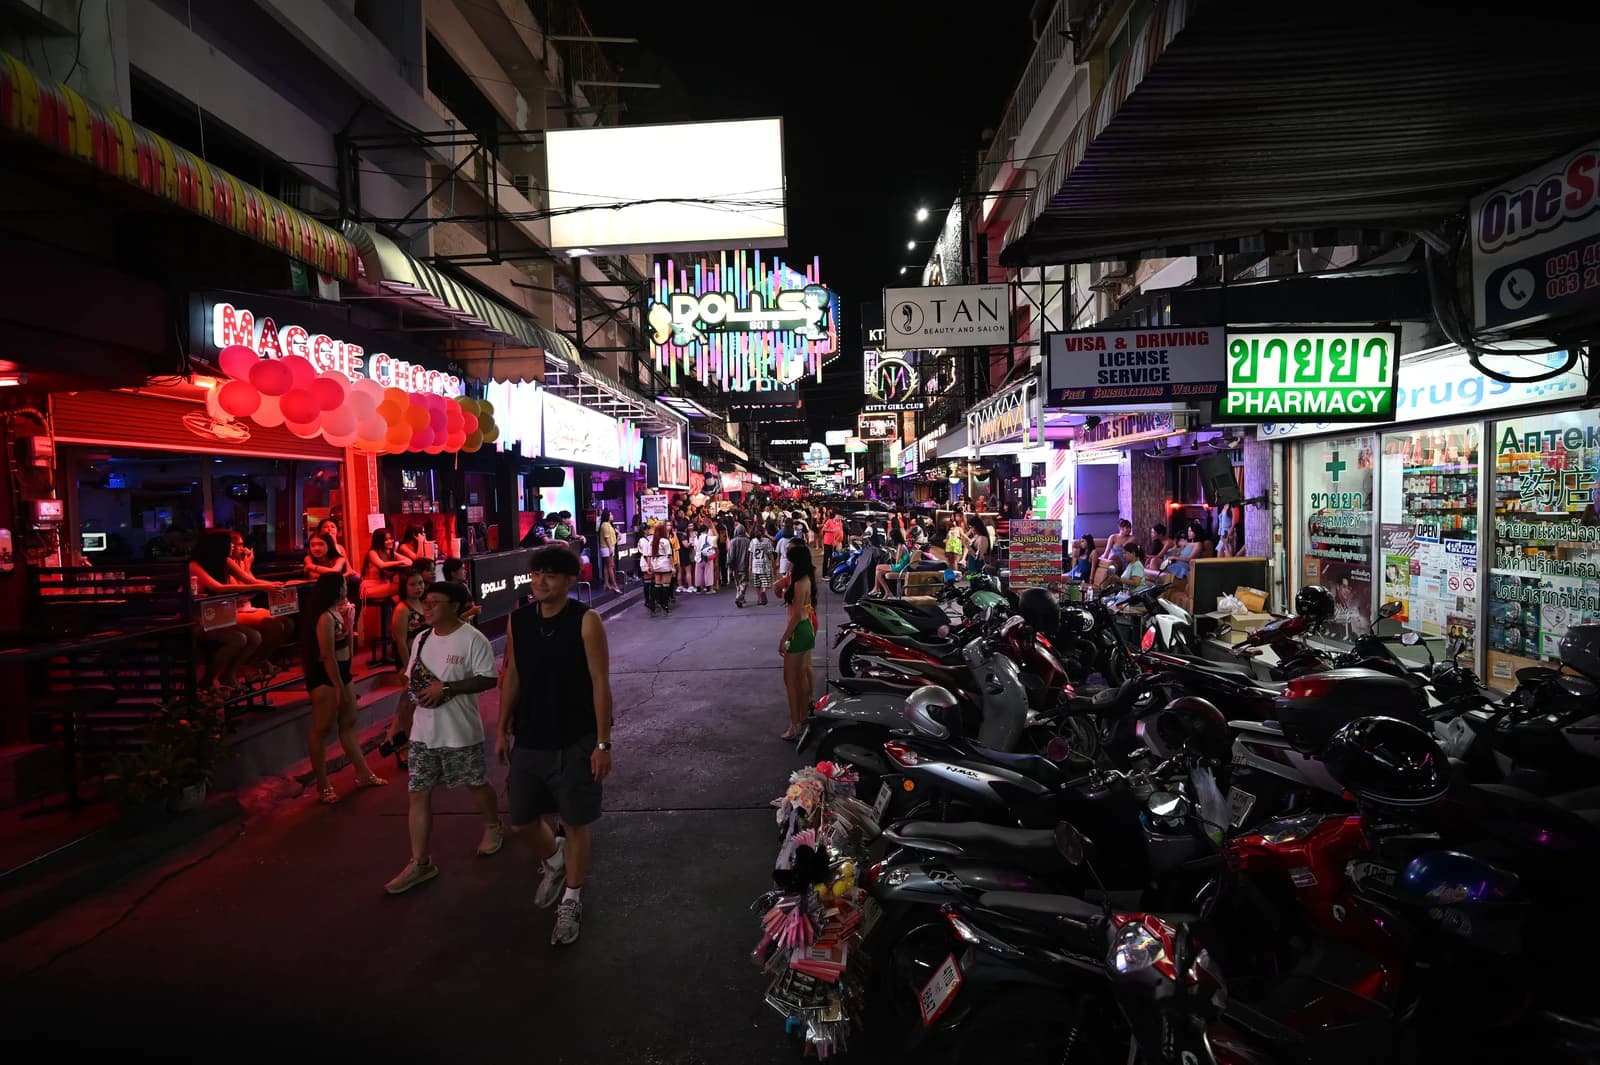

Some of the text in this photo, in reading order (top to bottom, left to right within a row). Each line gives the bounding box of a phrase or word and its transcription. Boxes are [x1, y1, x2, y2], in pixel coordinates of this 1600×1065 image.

[1482, 154, 1600, 243] OneS
[1547, 251, 1578, 277] 094
[1547, 273, 1579, 299] 083
[671, 293, 807, 325] DOLLS
[929, 297, 998, 323] TAN
[213, 303, 364, 382] MAGGIE
[1065, 331, 1209, 352] VISA & DRIVING
[1099, 350, 1168, 367] LICENSE
[1229, 337, 1388, 383] ขายยา
[369, 353, 461, 399] CHOO'S
[1097, 367, 1170, 384] SERVICE
[1227, 390, 1386, 413] PHARMACY
[1519, 465, 1598, 506] 药店
[1311, 491, 1362, 509] ขายยา
[1417, 523, 1438, 539] OPEN
[1496, 546, 1600, 578] ให้คำปรึกษาเรื่อ
